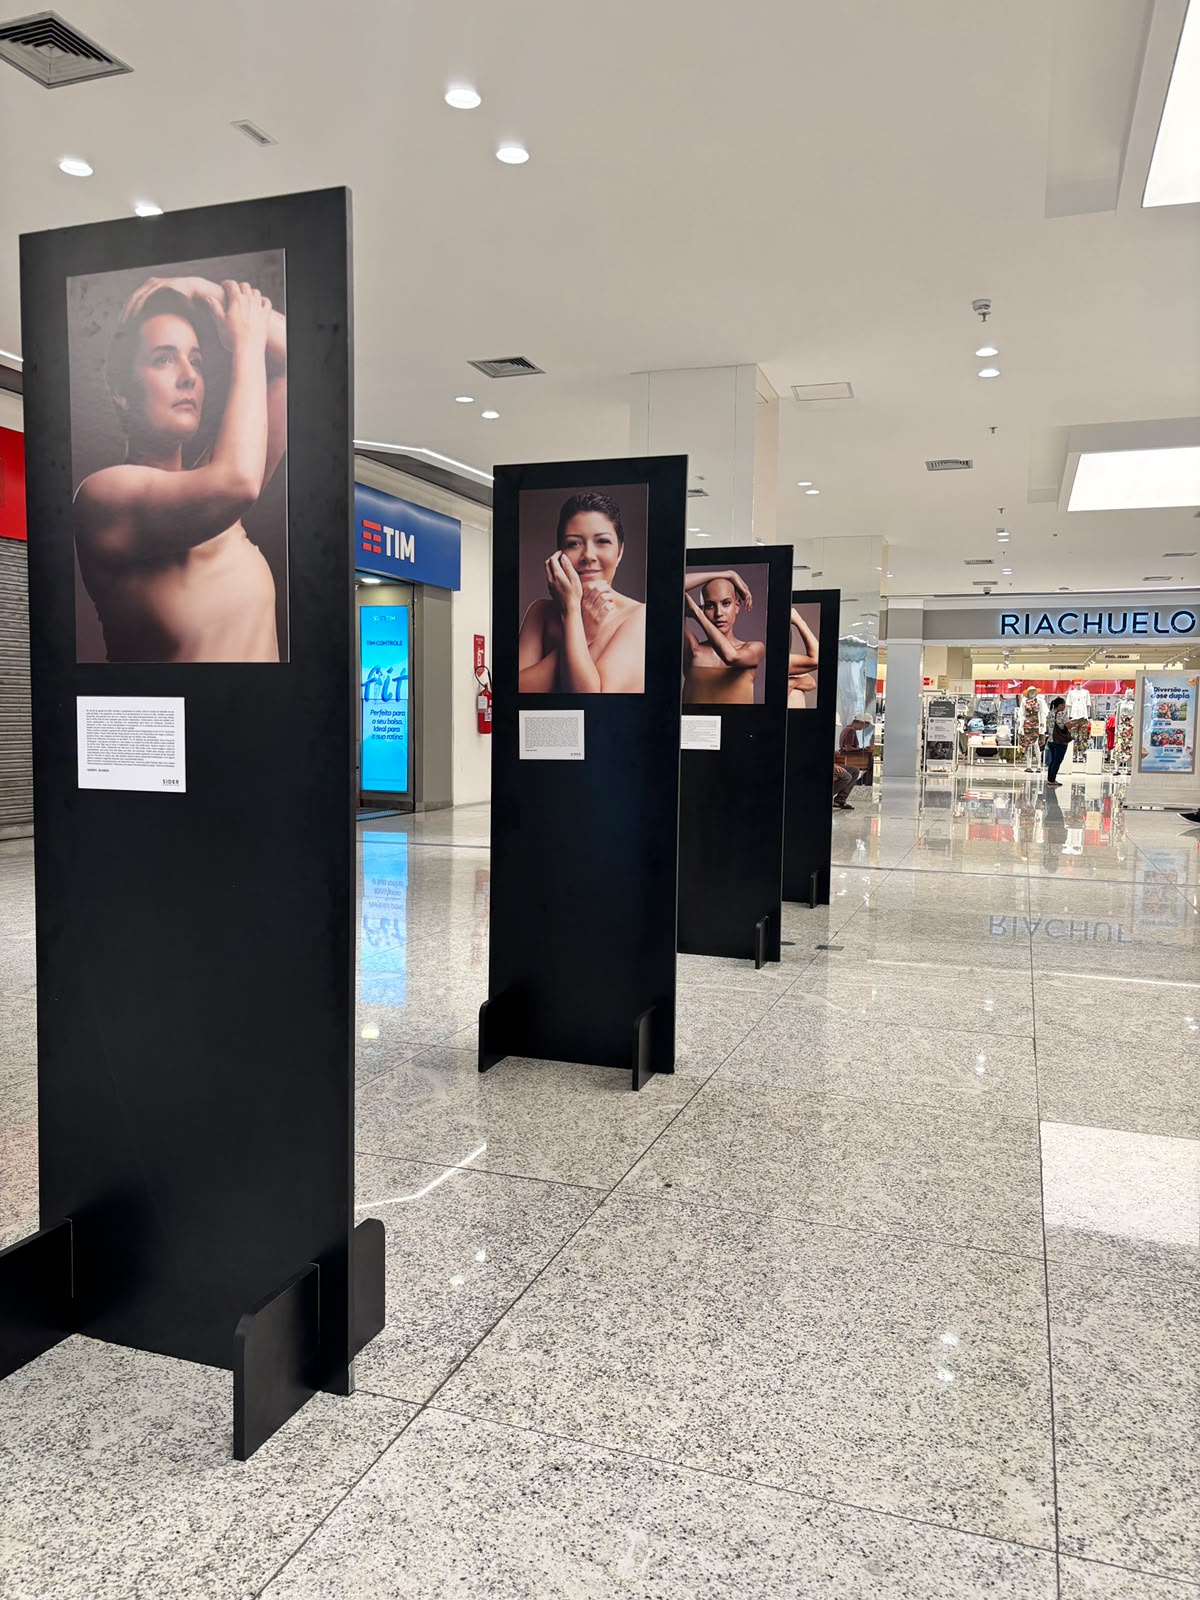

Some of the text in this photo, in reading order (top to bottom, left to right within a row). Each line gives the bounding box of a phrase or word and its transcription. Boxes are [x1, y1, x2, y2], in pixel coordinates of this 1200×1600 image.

[383, 525, 415, 563] TIM
[1001, 610, 1196, 635] RIACHUELO
[1168, 692, 1190, 700] dupla
[370, 709, 392, 717] Perfeito
